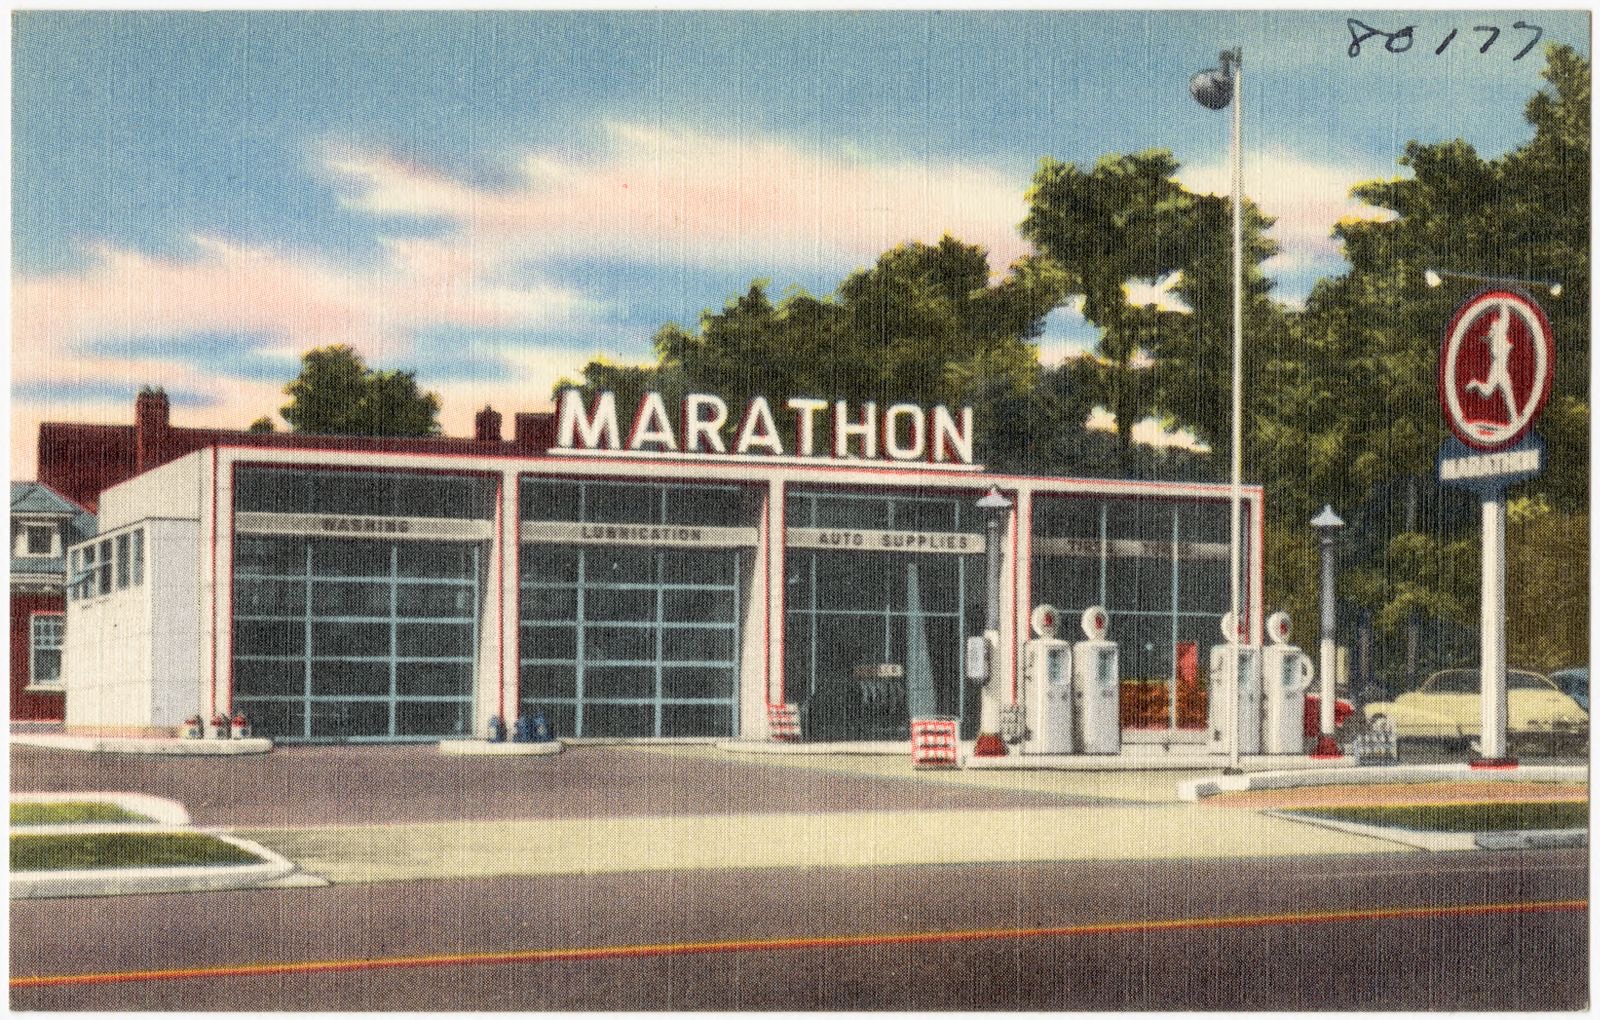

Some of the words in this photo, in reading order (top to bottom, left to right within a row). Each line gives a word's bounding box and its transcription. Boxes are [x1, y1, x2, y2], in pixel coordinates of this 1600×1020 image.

[556, 389, 974, 464] MARATHON
[321, 518, 409, 533] WASHING
[581, 525, 701, 541] LUBRICATION
[819, 531, 863, 546] AUTO
[882, 534, 967, 549] SUPPLIES
